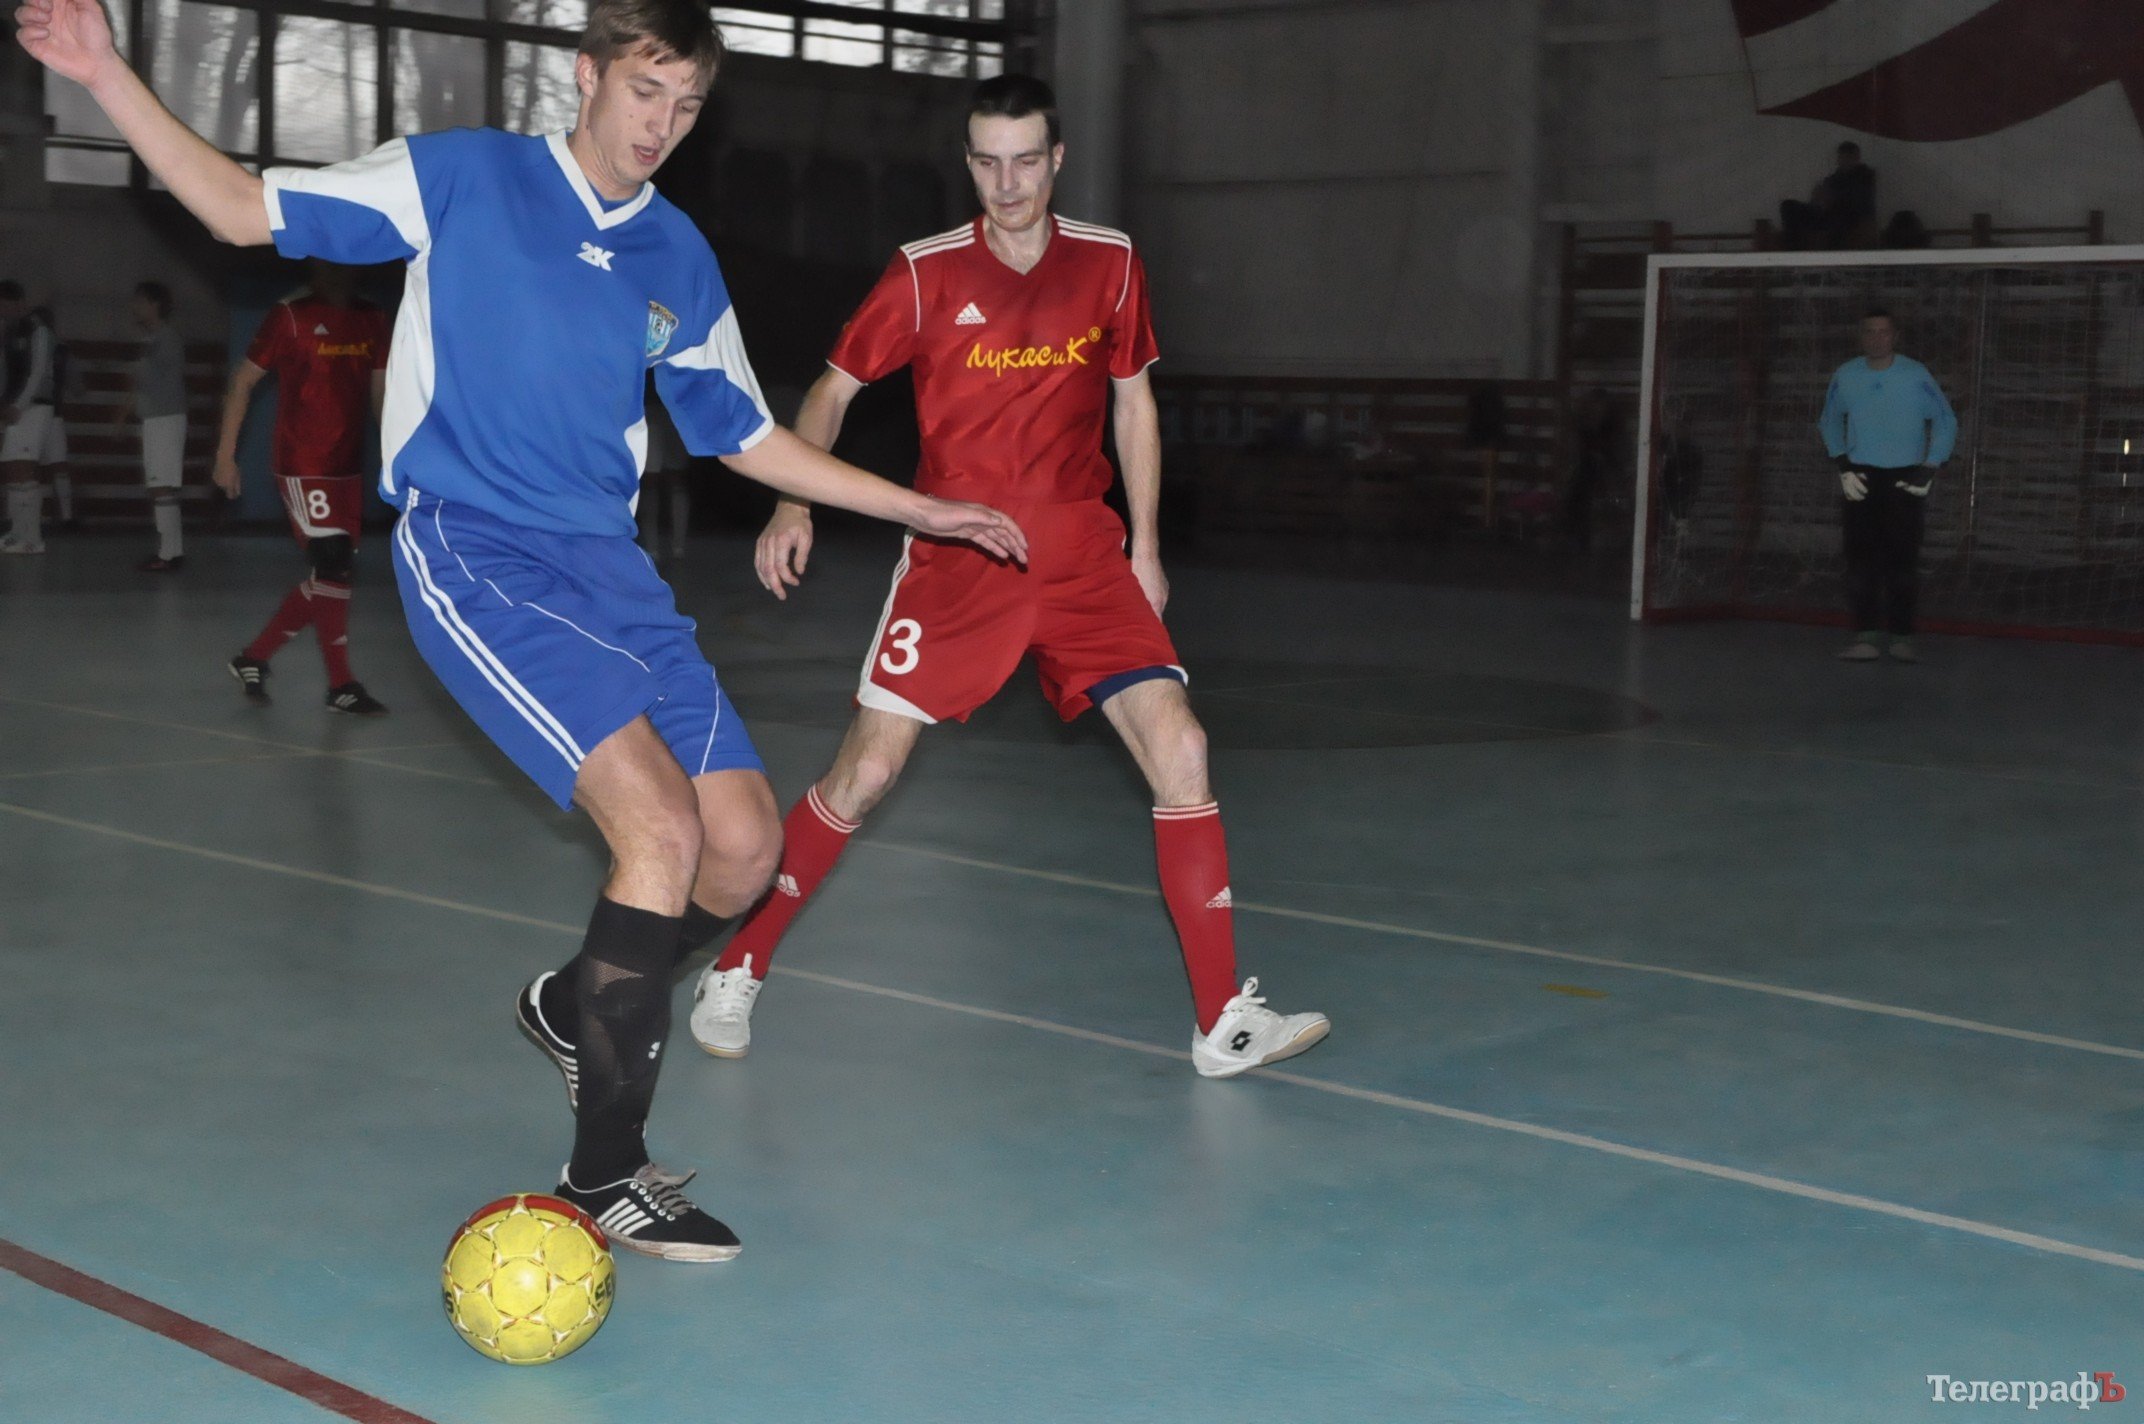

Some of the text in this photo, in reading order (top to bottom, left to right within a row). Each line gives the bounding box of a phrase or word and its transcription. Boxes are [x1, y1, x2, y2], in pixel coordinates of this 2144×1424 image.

[955, 315, 986, 325] adidas
[308, 489, 330, 520] 8
[880, 618, 922, 675] 3
